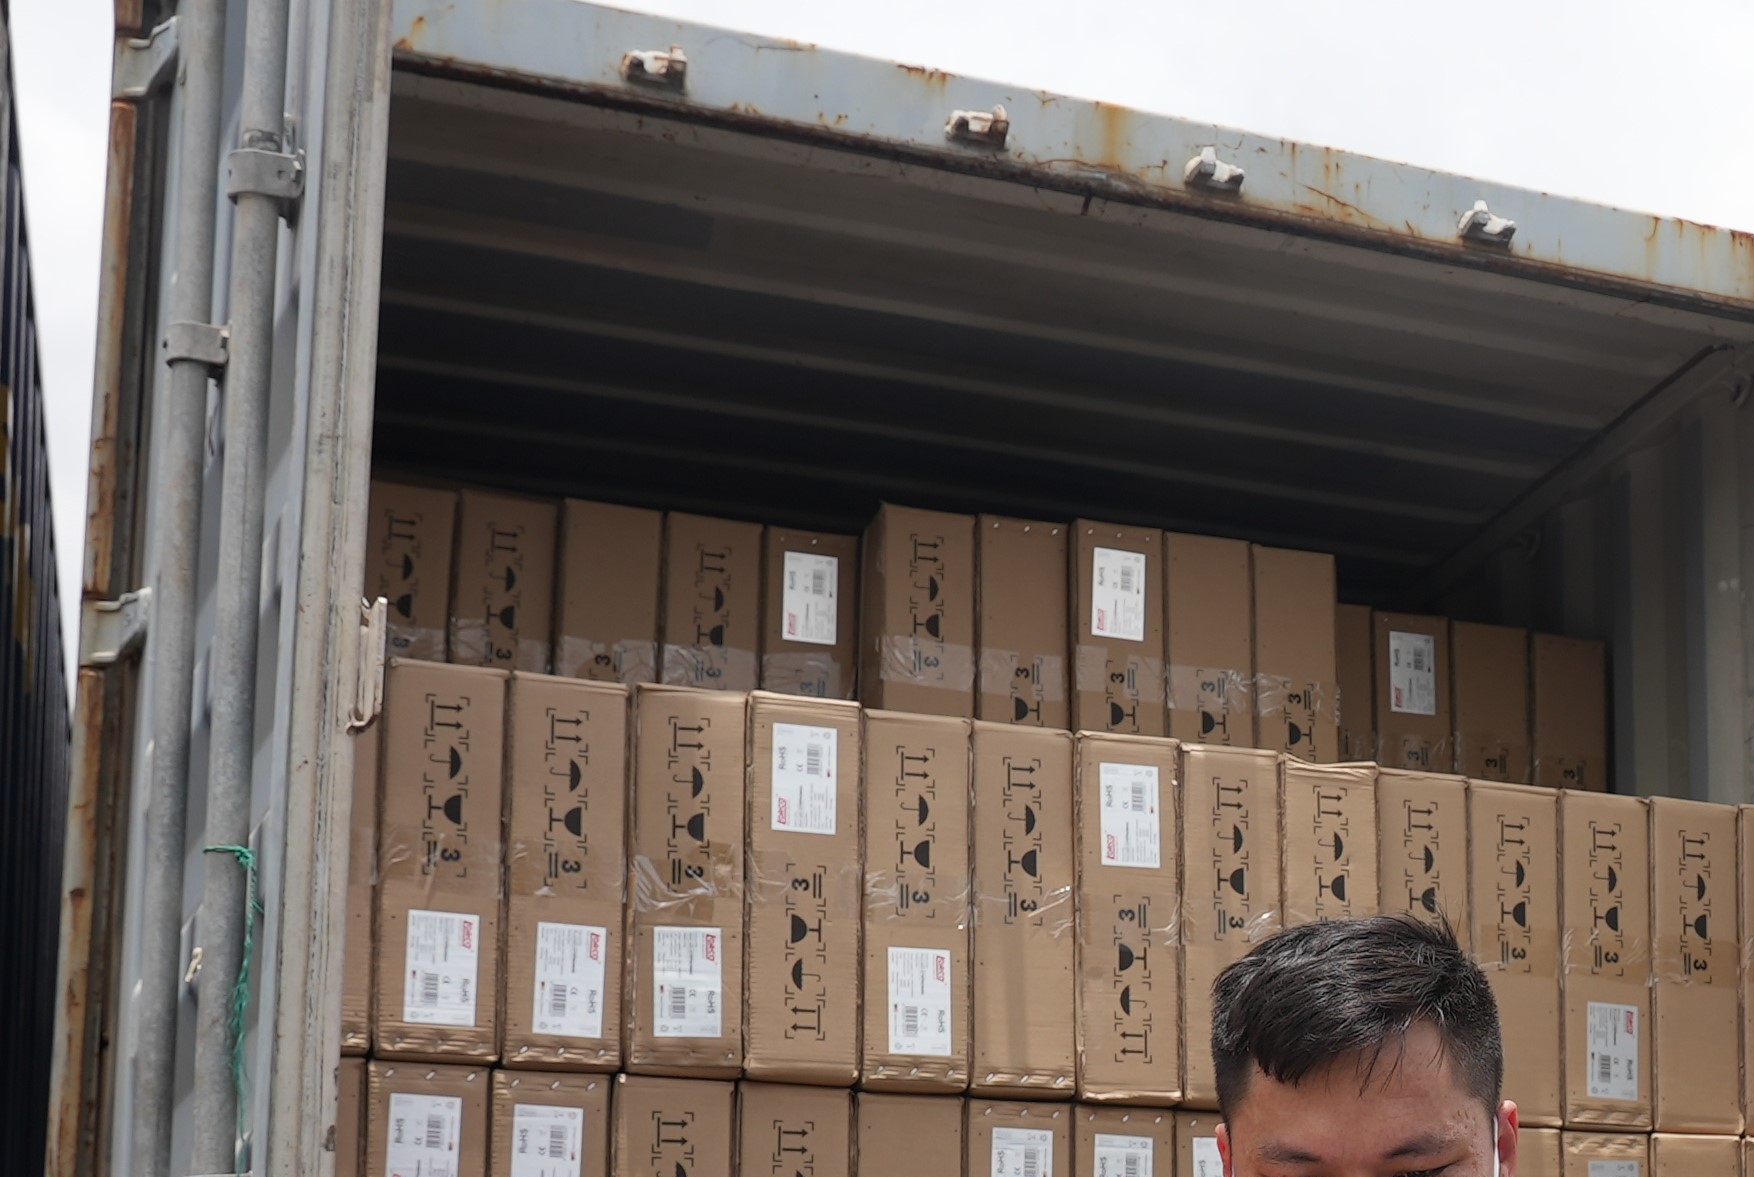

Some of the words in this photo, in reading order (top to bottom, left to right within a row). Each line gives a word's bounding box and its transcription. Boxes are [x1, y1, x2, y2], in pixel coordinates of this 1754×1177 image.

[495, 648, 512, 660] 3
[594, 654, 611, 666] 3
[1015, 667, 1030, 679] 3
[1110, 672, 1125, 684] 3
[1201, 681, 1216, 693] 3
[1288, 693, 1302, 704] 3
[1485, 758, 1498, 768] 3
[440, 848, 461, 862] 3
[561, 860, 581, 873] 3
[792, 878, 810, 891] 3
[912, 891, 930, 903] 3
[1020, 899, 1037, 912] 3
[1118, 909, 1135, 922] 3
[1229, 916, 1244, 929] 3
[1511, 947, 1526, 960] 3
[1604, 951, 1619, 963] 3
[1693, 959, 1708, 971] 3
